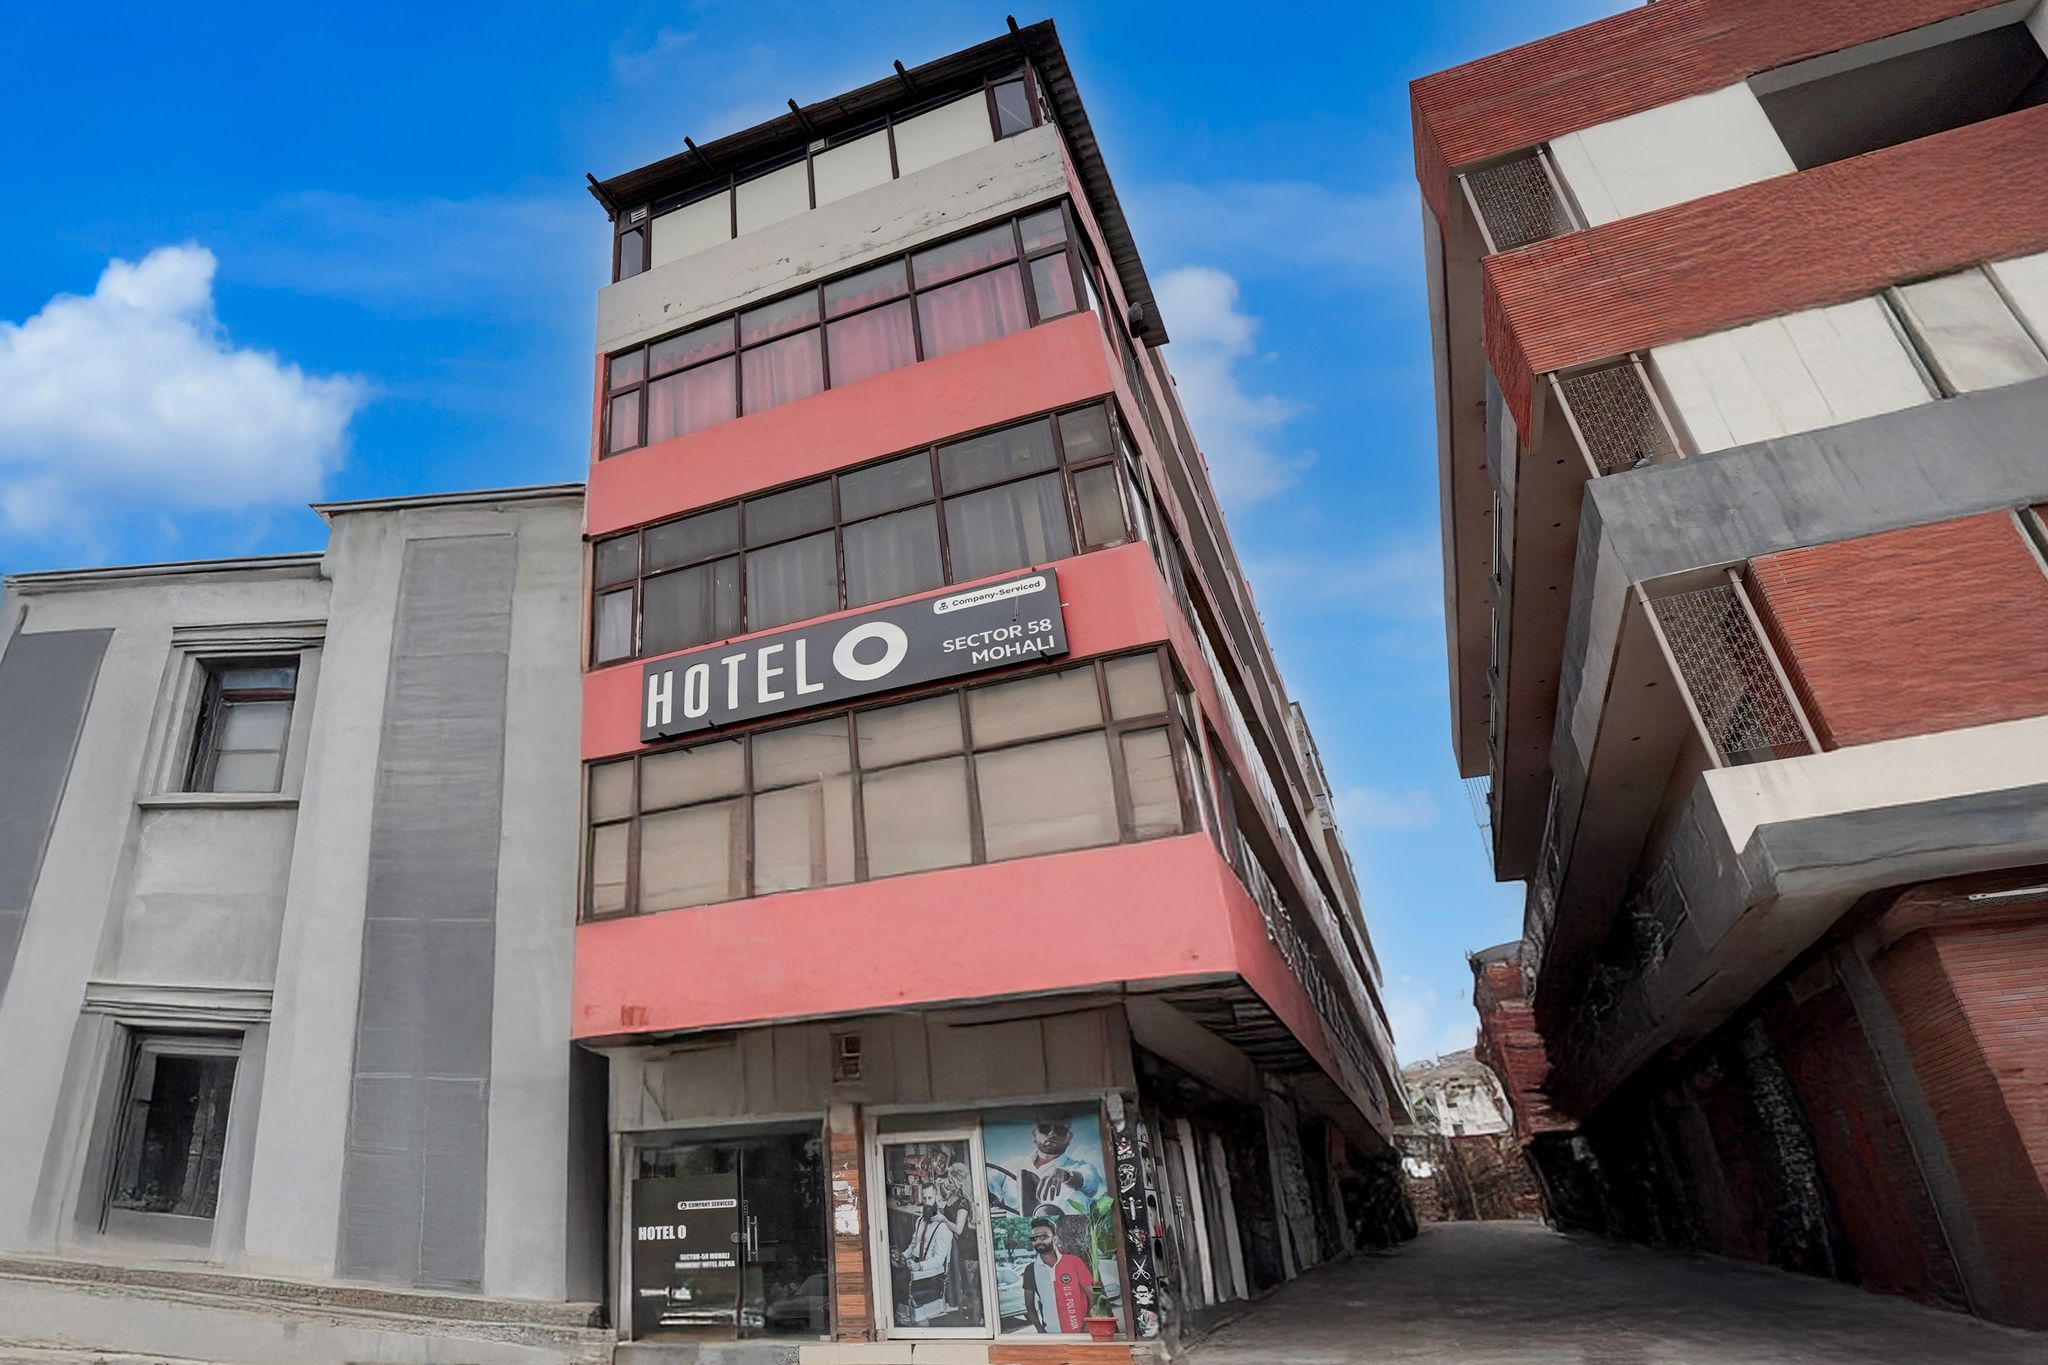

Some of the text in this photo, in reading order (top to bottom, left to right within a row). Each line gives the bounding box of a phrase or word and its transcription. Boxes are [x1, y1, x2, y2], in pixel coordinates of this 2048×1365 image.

[952, 581, 1041, 606] Company-Serviced
[943, 618, 1052, 653] SECTOR 58
[971, 635, 1055, 664] MOHALI
[646, 621, 908, 728] HOTEL O
[638, 1225, 687, 1241] HOTEL O
